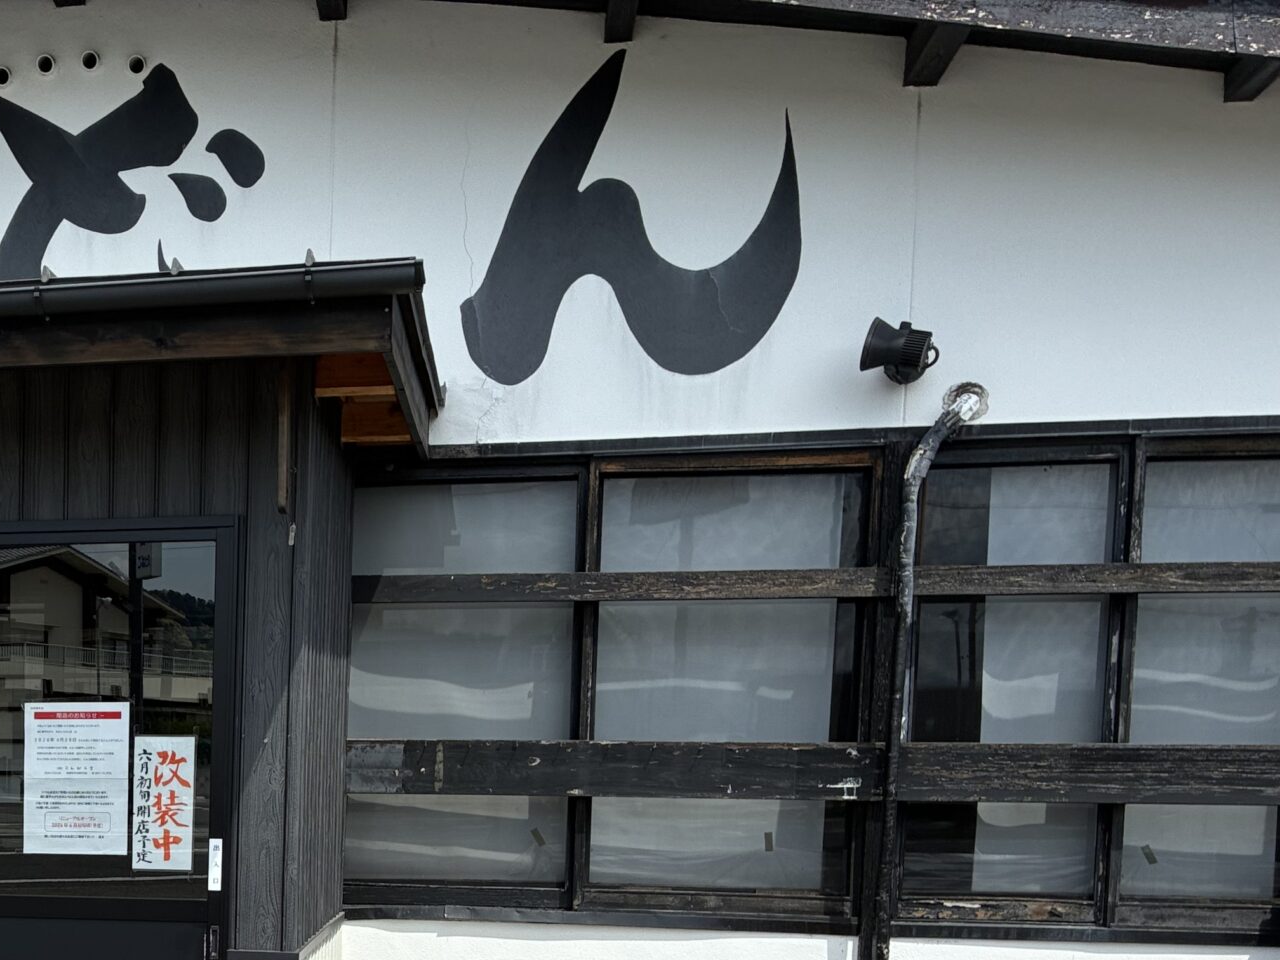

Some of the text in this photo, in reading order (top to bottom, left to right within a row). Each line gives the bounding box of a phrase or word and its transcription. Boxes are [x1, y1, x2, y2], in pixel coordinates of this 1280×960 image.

[134, 748, 153, 864] 六月初旬開店予定
[151, 750, 191, 862] 改装中
[212, 844, 220, 884] 出入口
